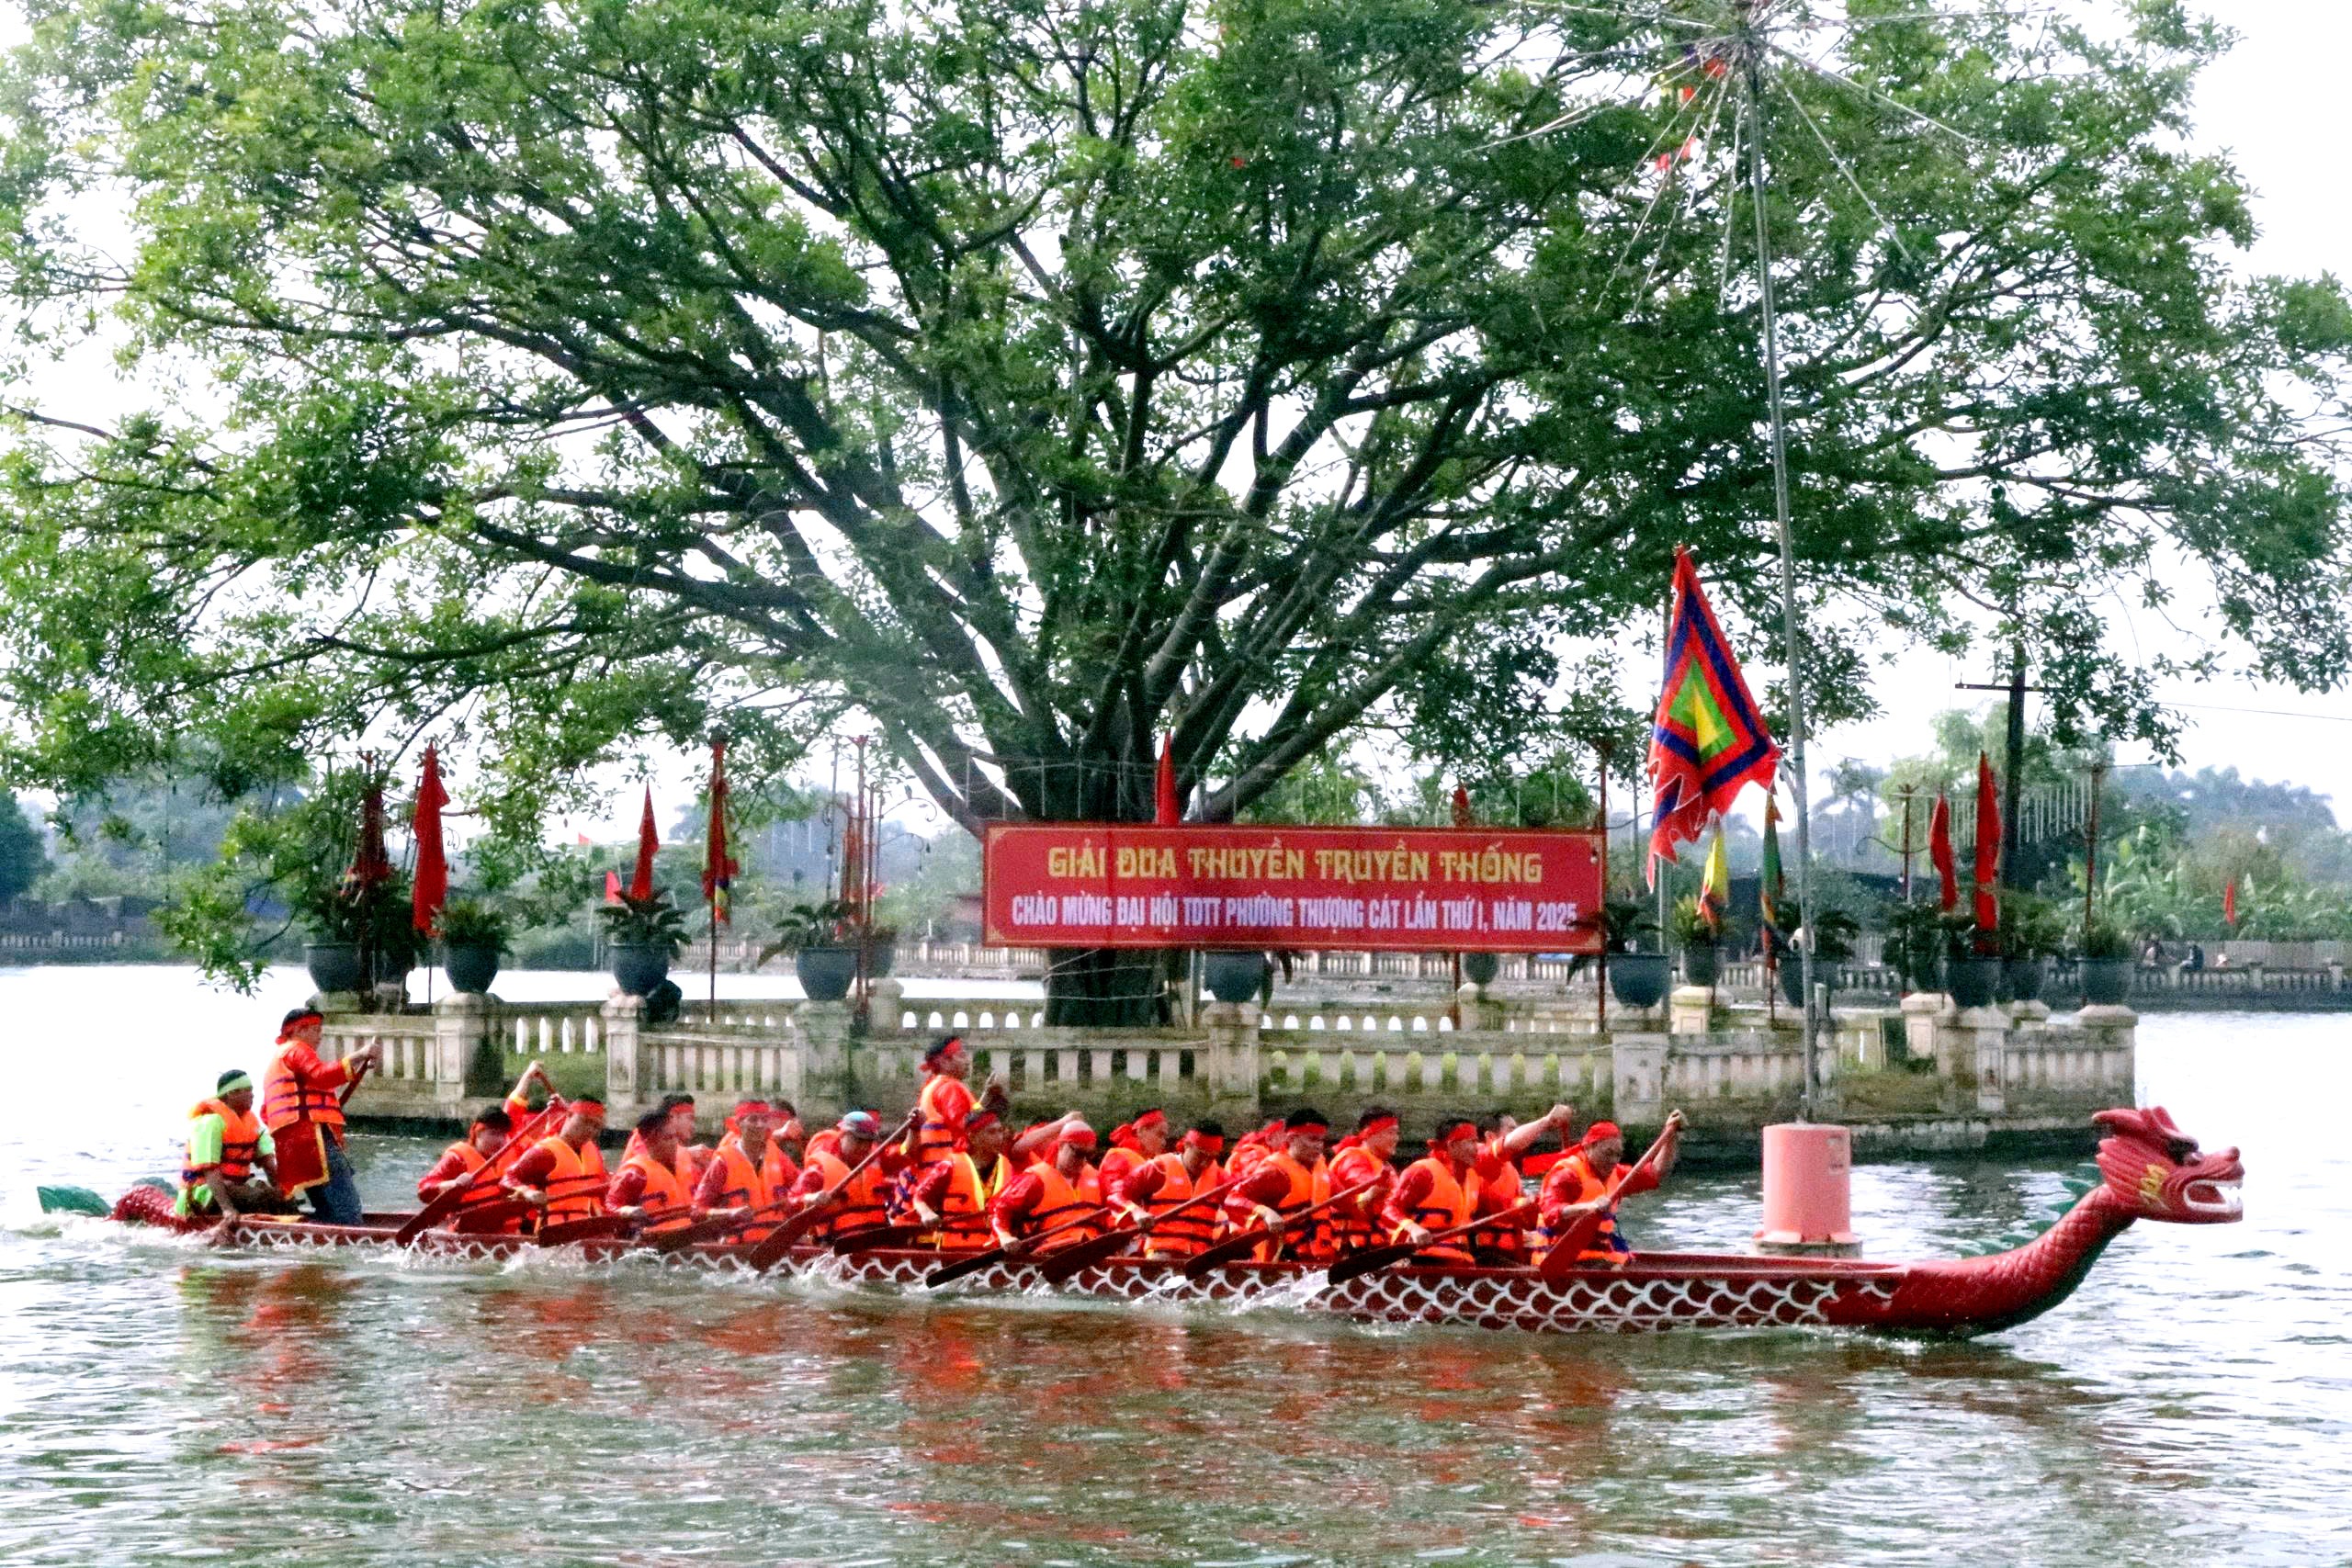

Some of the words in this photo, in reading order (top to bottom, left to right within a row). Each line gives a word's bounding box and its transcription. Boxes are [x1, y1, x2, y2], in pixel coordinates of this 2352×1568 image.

[1048, 838, 1106, 878] GIẢI
[1115, 847, 1177, 878] ĐUA
[1187, 836, 1305, 879] THUYỀN
[1315, 839, 1429, 884] TRUYỀN
[1439, 841, 1543, 883] THỐNG
[1012, 889, 1057, 926] CHÀO
[1061, 889, 1112, 926] MỪNG
[1116, 896, 1146, 932] ĐẠI
[1149, 890, 1178, 932] HỘI
[1182, 897, 1221, 927] TDTT
[1225, 890, 1294, 927] PHƯỜNG
[1298, 896, 1364, 934] THƯỢNG
[1368, 893, 1400, 929] CÁT
[1442, 895, 1476, 931] THỨ
[1477, 900, 1488, 933] I,
[1493, 895, 1532, 931] NĂM
[1536, 901, 1577, 931] 2025
